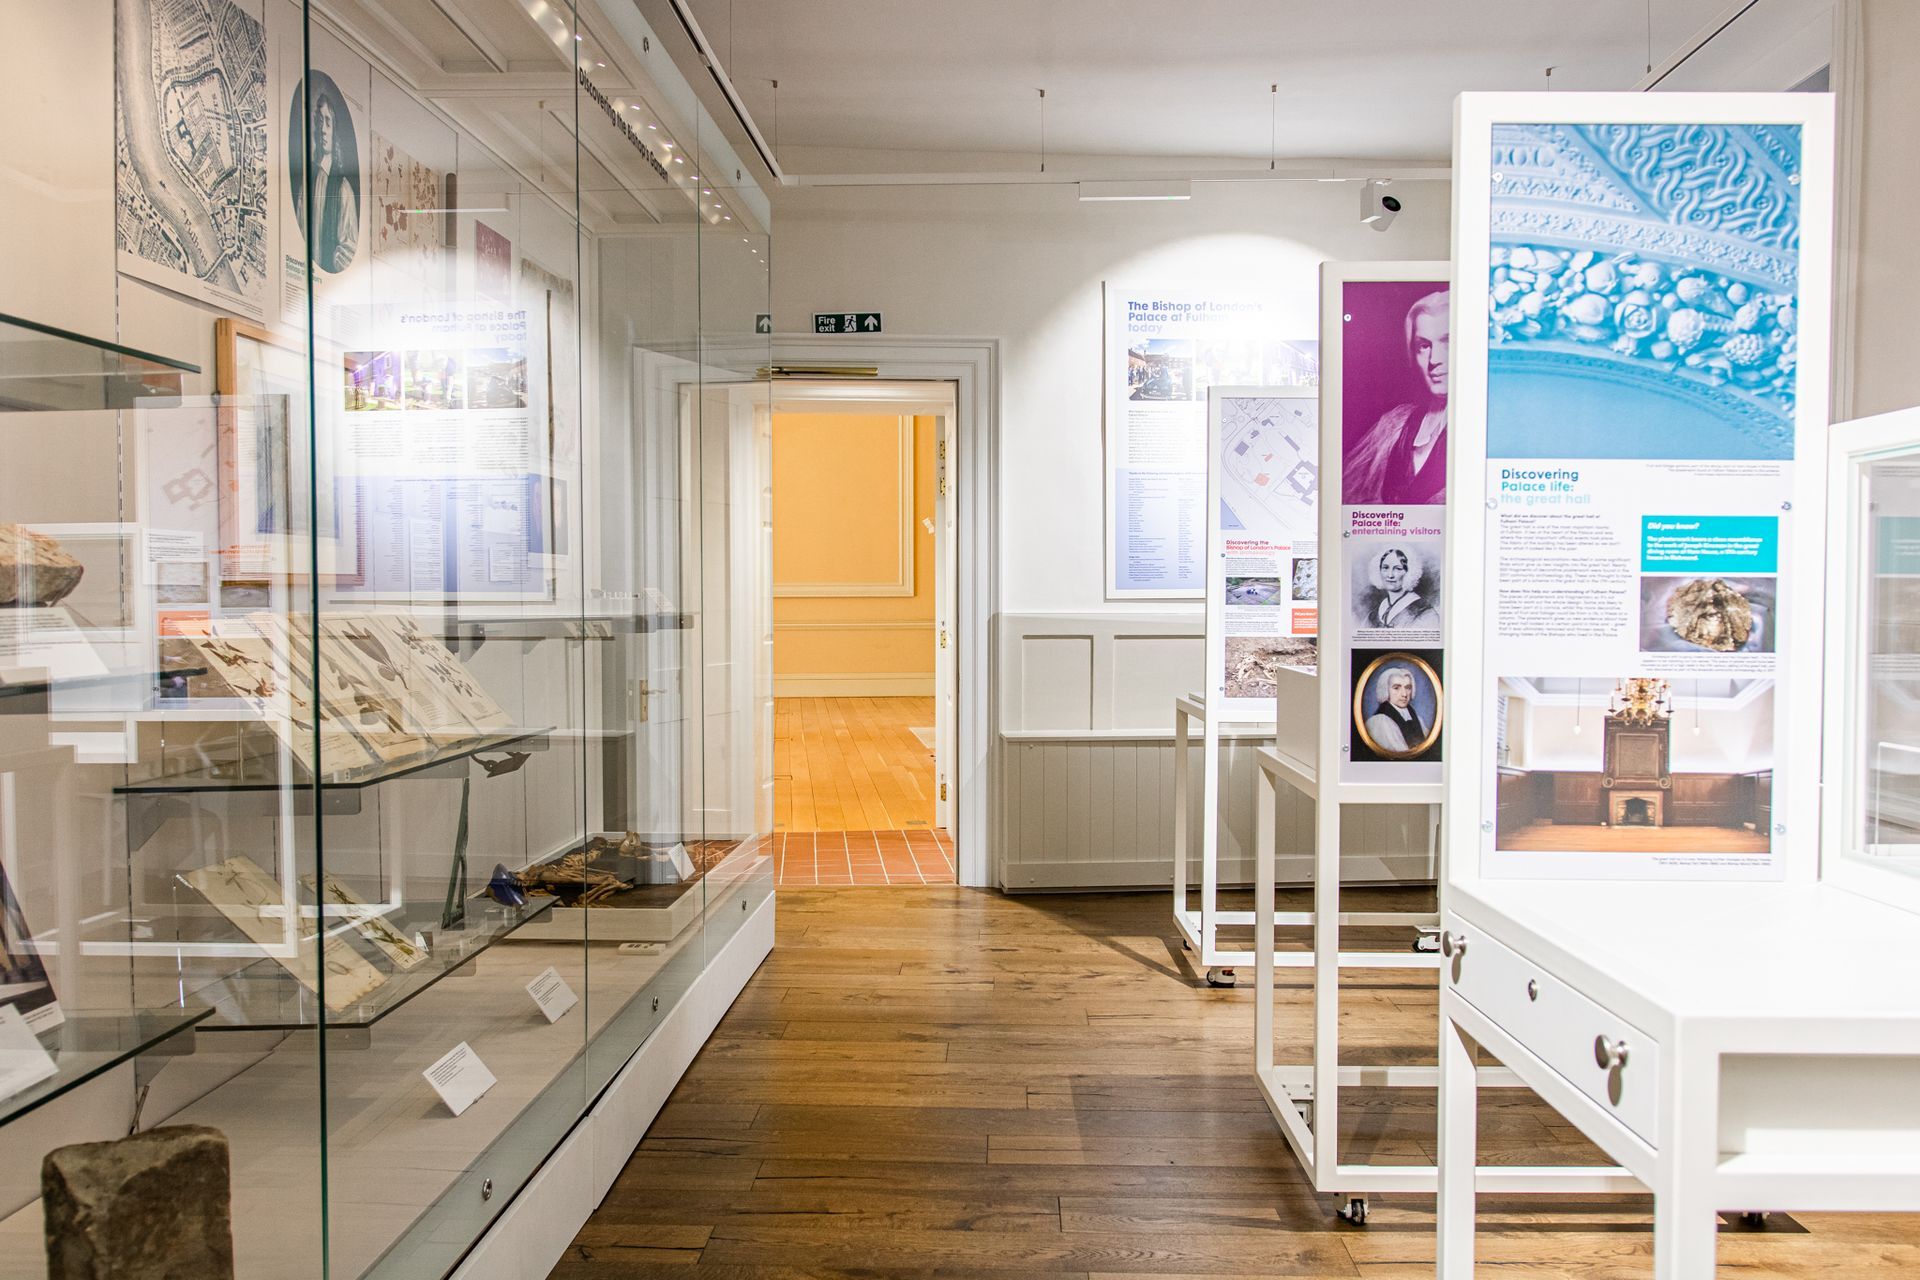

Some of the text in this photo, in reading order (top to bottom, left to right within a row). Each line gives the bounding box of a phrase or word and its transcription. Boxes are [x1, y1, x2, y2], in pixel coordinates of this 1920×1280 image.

[579, 67, 669, 184] Discovering the Bishop's Garden
[1128, 301, 1263, 313] The Bishop of London's
[818, 316, 836, 325] Fire
[1128, 312, 1167, 322] Palace
[1171, 313, 1183, 322] at
[1128, 323, 1162, 334] today
[1502, 468, 1579, 481] Discovering
[1501, 481, 1574, 492] Palace life:
[1501, 493, 1590, 506] the great hall
[1352, 510, 1404, 520] Discovering
[1384, 519, 1401, 527] life:
[1352, 527, 1441, 536] entertaining visitors
